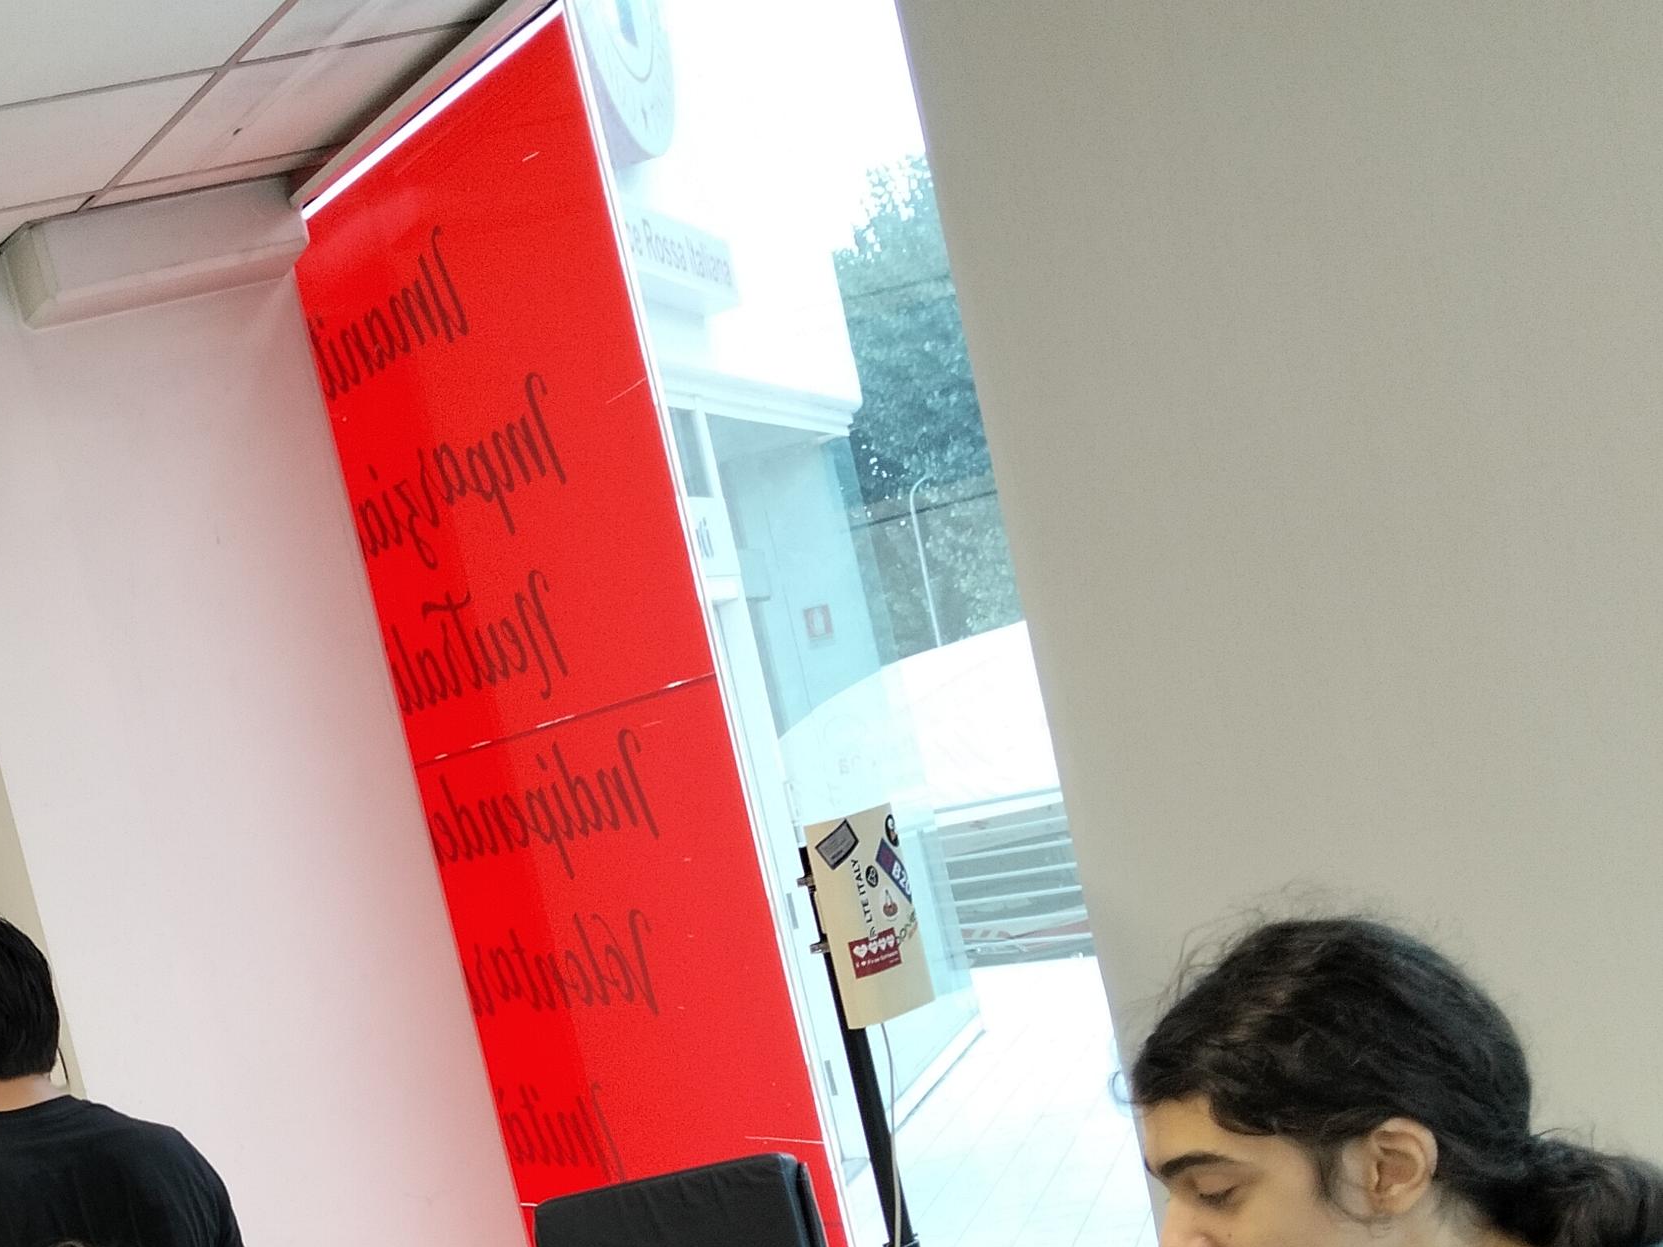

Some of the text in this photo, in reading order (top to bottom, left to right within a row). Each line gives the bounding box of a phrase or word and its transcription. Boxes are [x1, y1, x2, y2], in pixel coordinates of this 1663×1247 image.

[641, 217, 687, 272] Rossa
[684, 234, 733, 287] Italiana
[850, 858, 873, 924] LTE ITALY
